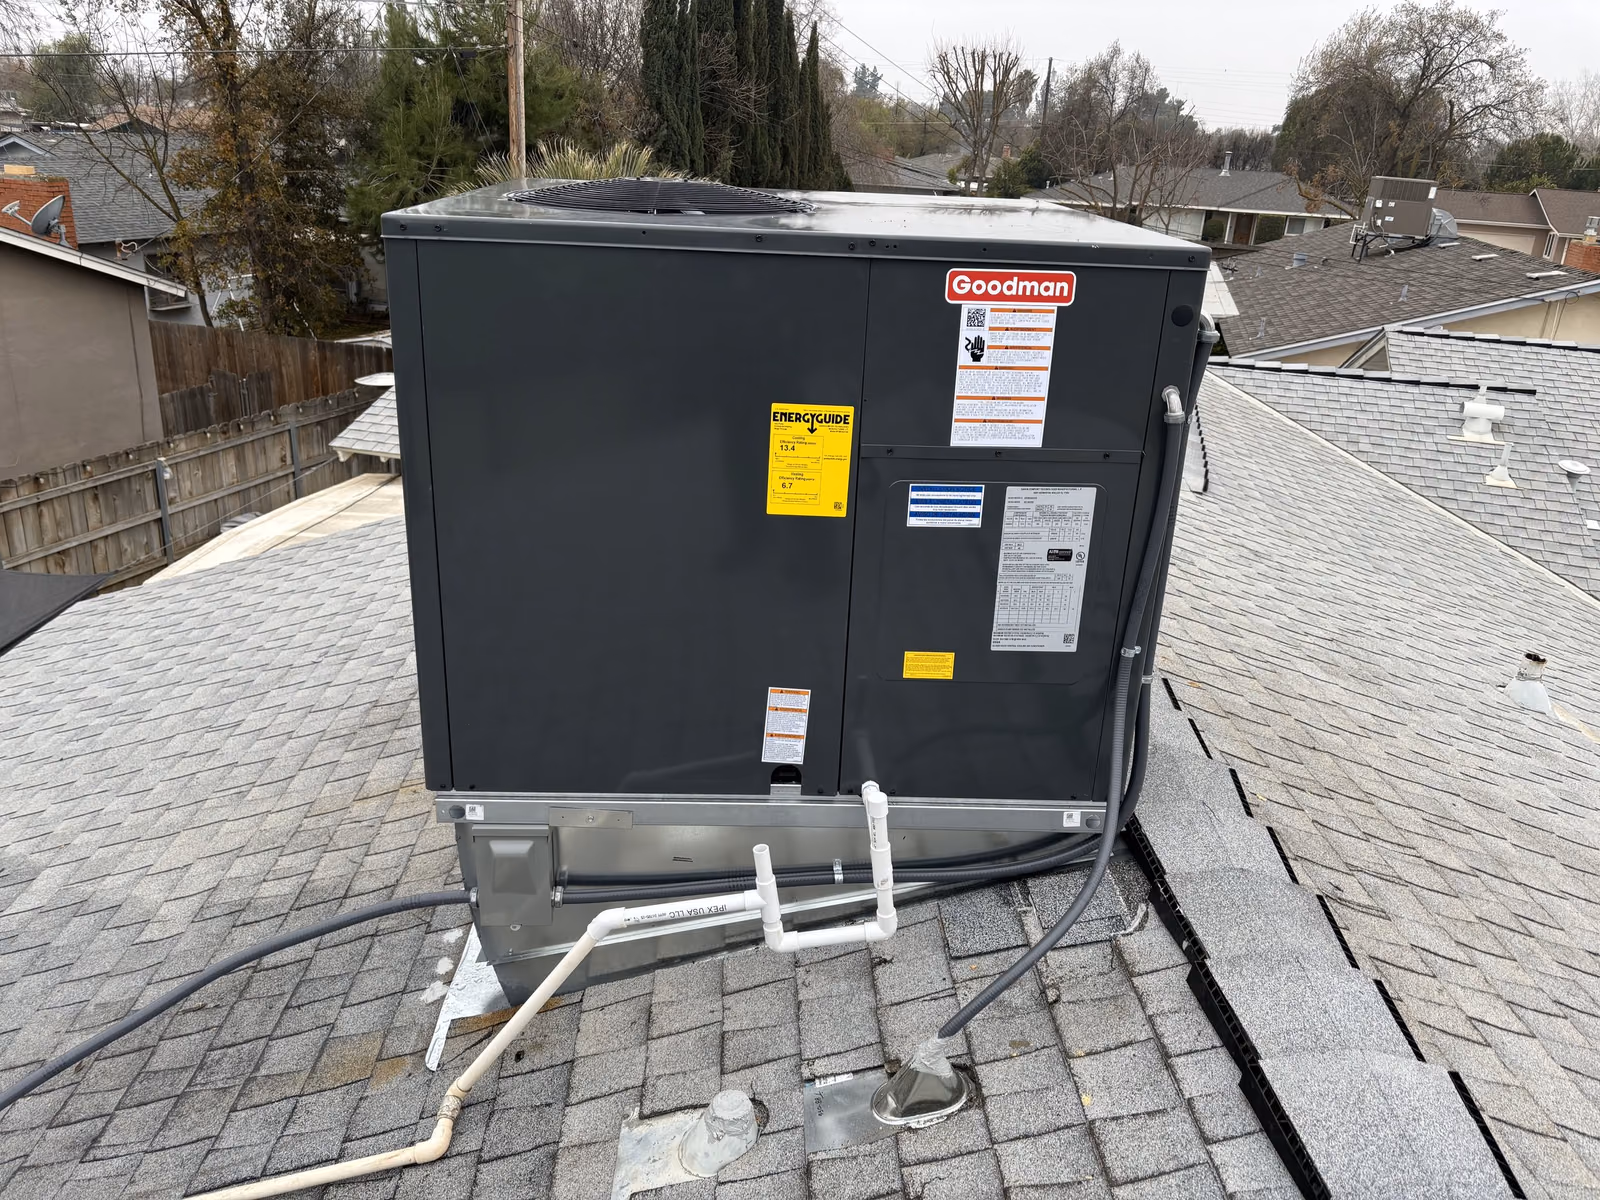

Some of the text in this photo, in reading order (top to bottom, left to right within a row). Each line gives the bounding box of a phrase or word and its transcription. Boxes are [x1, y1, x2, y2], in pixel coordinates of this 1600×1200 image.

[952, 275, 1068, 297] Goodman
[773, 412, 850, 425] ENERGYGUIDE
[780, 444, 796, 452] 13.4
[686, 907, 705, 917] USA
[706, 904, 727, 914] IPEX
[668, 910, 685, 919] LLC
